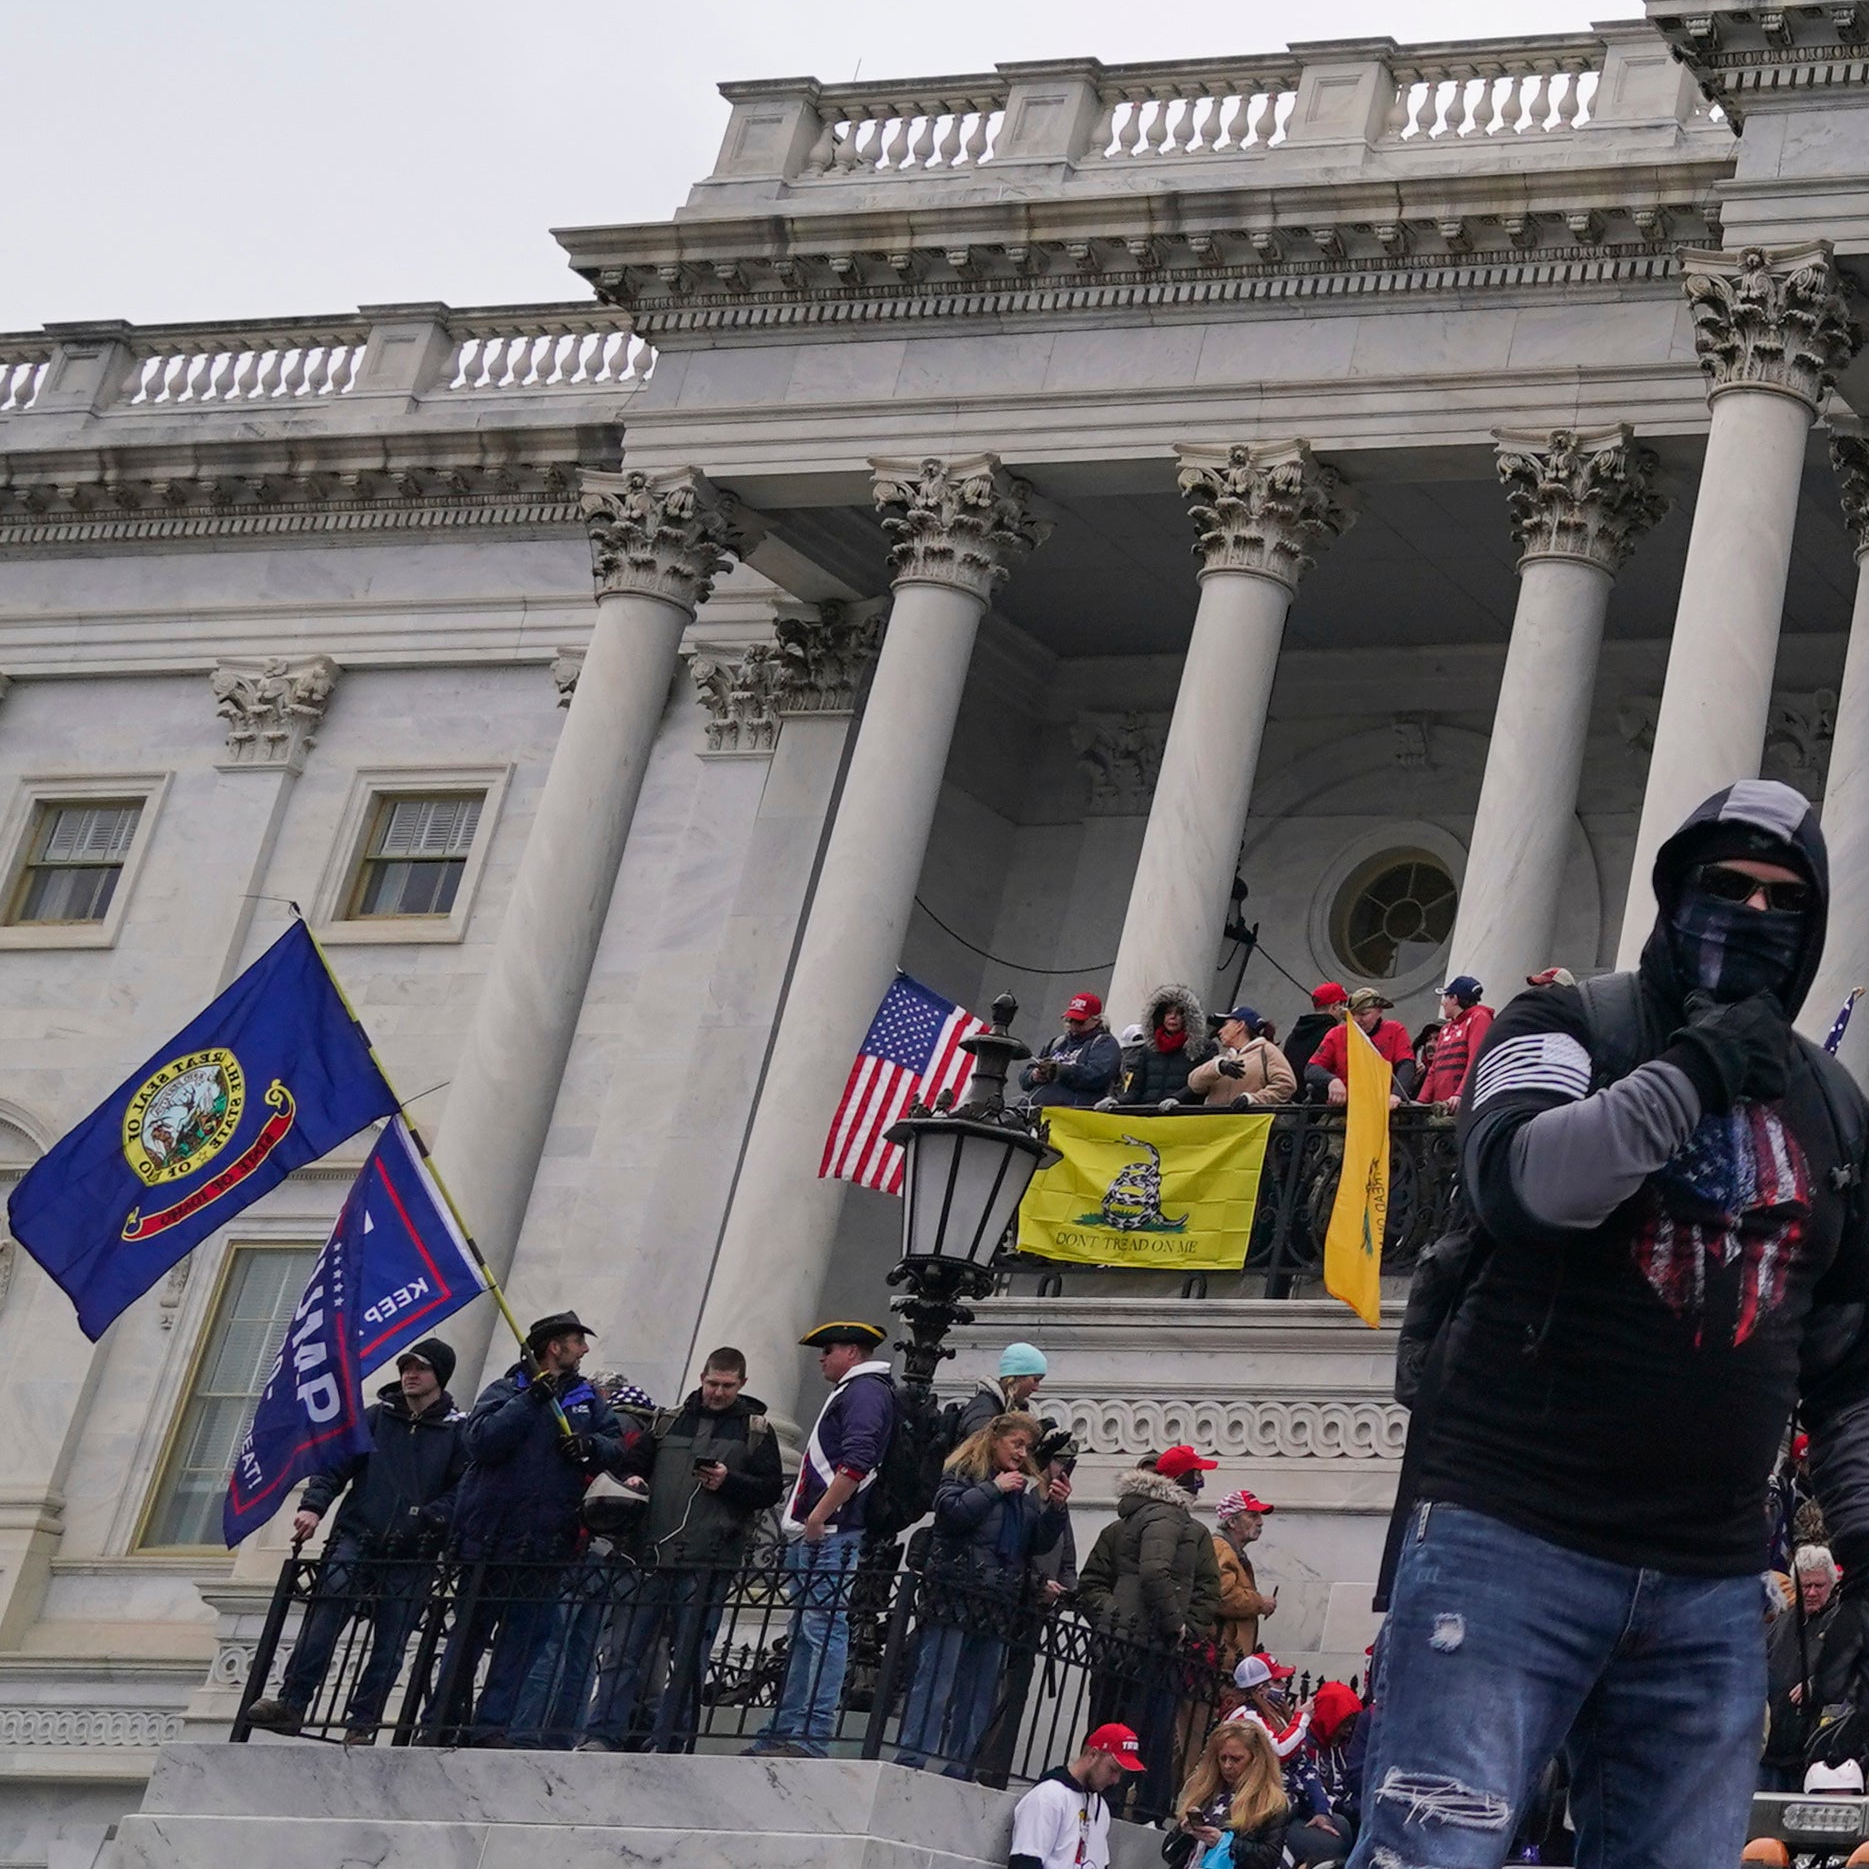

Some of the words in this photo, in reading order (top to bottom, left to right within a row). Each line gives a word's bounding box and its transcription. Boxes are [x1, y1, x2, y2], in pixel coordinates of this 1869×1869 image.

[1104, 1237, 1149, 1252] TREAD
[1152, 1243, 1174, 1252] ON
[1176, 1240, 1199, 1253] ME
